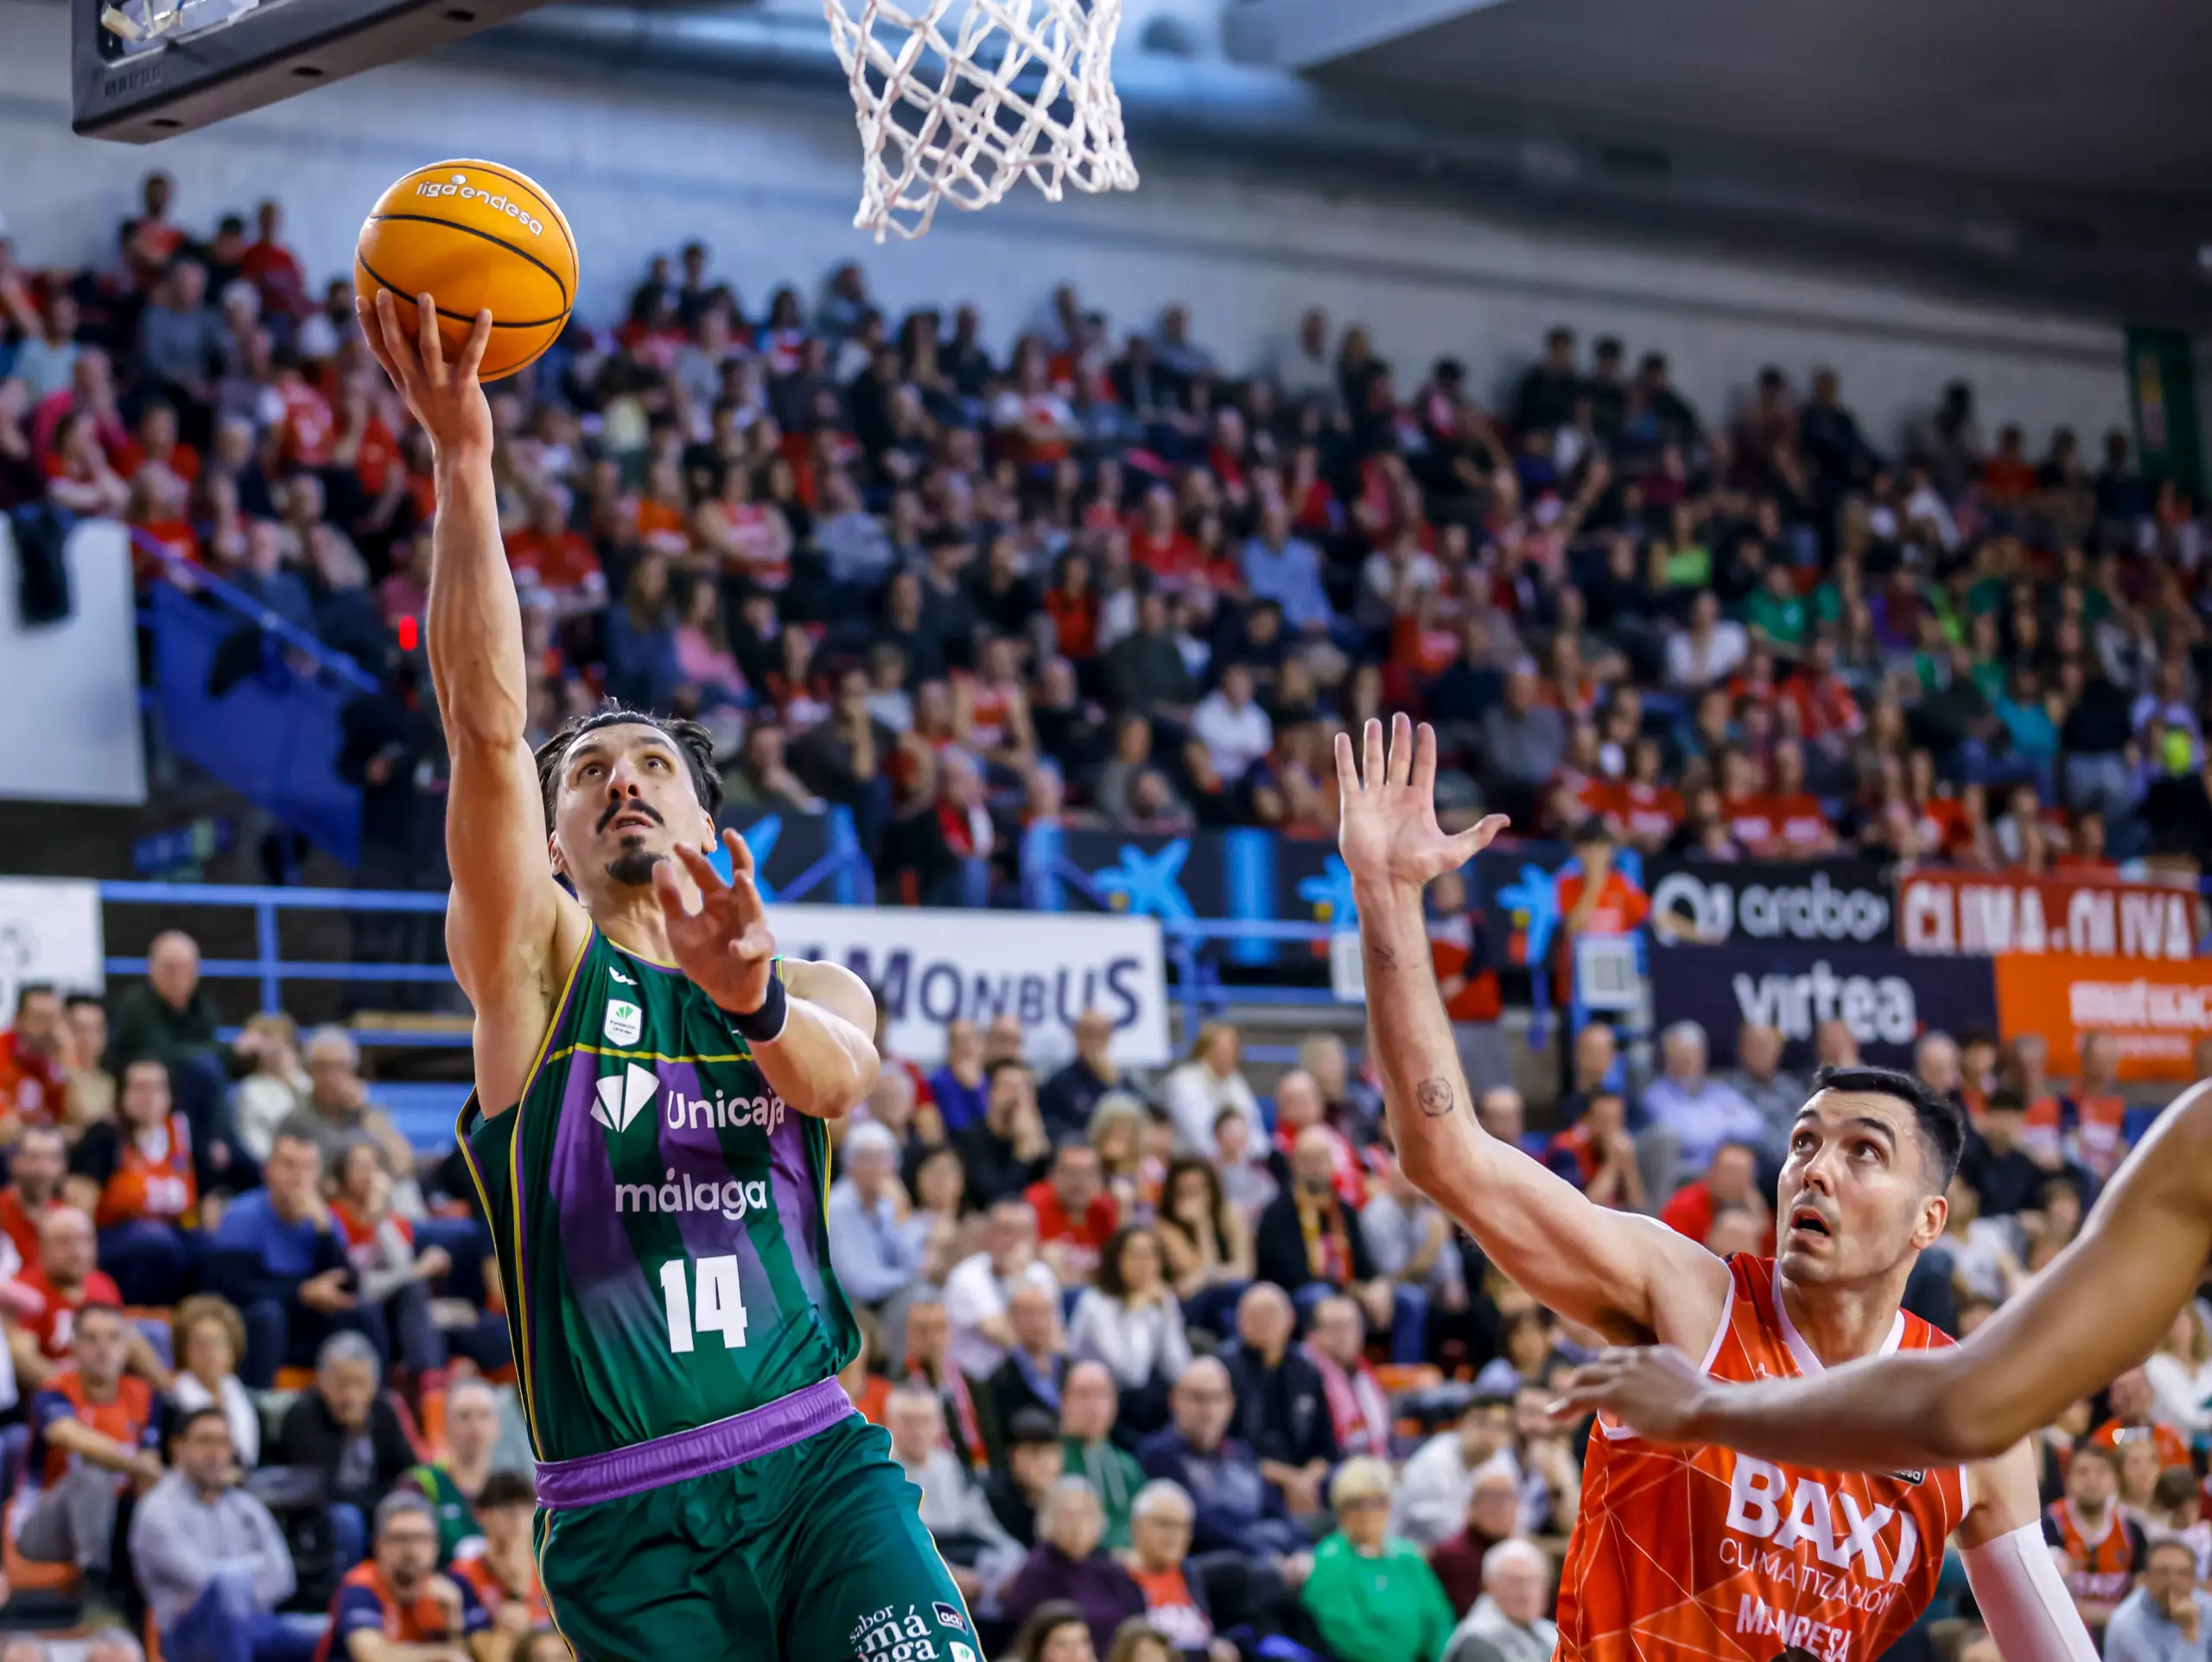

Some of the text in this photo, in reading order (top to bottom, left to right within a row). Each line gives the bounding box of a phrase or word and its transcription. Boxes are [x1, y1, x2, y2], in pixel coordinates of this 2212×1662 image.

[416, 181, 544, 237] liga endesa
[667, 1087, 785, 1137] Unicaja
[615, 1167, 767, 1220] málaga
[659, 1254, 748, 1353] 14
[1726, 1452, 1917, 1584] BAXI
[849, 1605, 893, 1644] sabor
